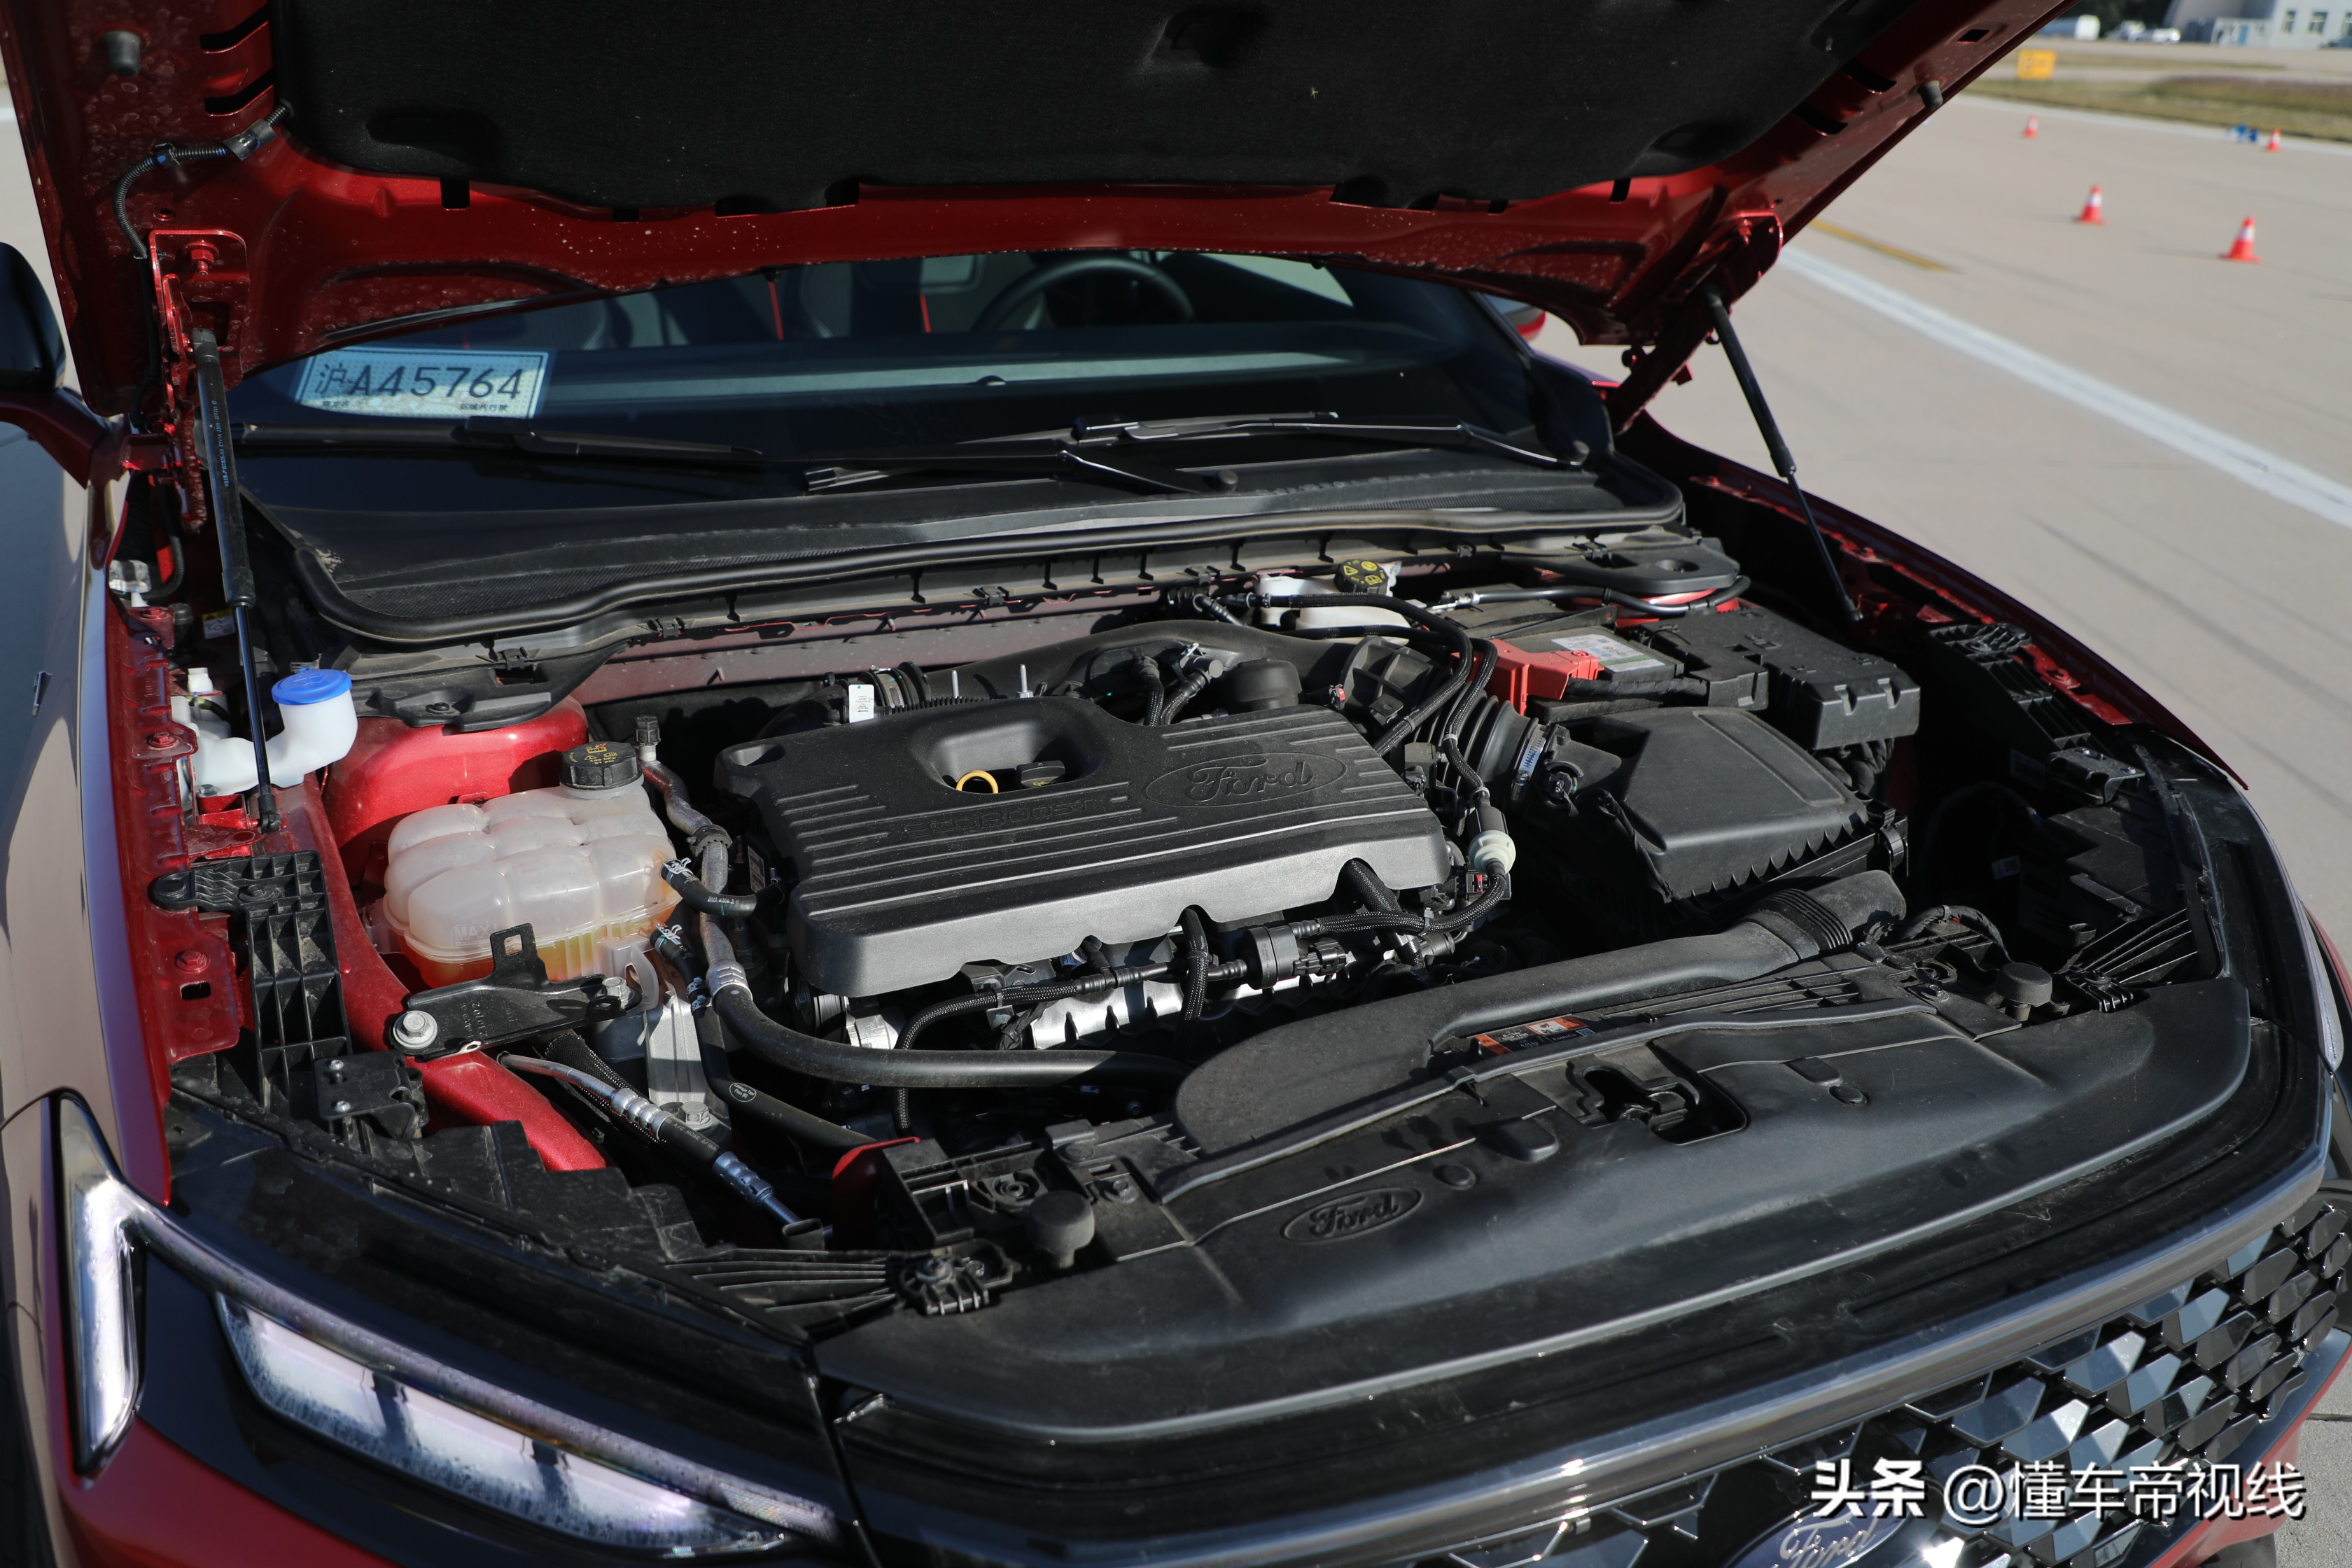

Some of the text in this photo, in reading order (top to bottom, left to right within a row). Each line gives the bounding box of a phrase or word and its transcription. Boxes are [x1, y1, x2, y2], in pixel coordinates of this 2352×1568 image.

[315, 363, 523, 398] 沪A45764
[1187, 760, 1312, 802] Ford
[454, 923, 491, 941] MAX
[673, 1123, 685, 1131] A/C
[685, 1130, 700, 1140] HOSE
[1309, 1193, 1399, 1236] Ford
